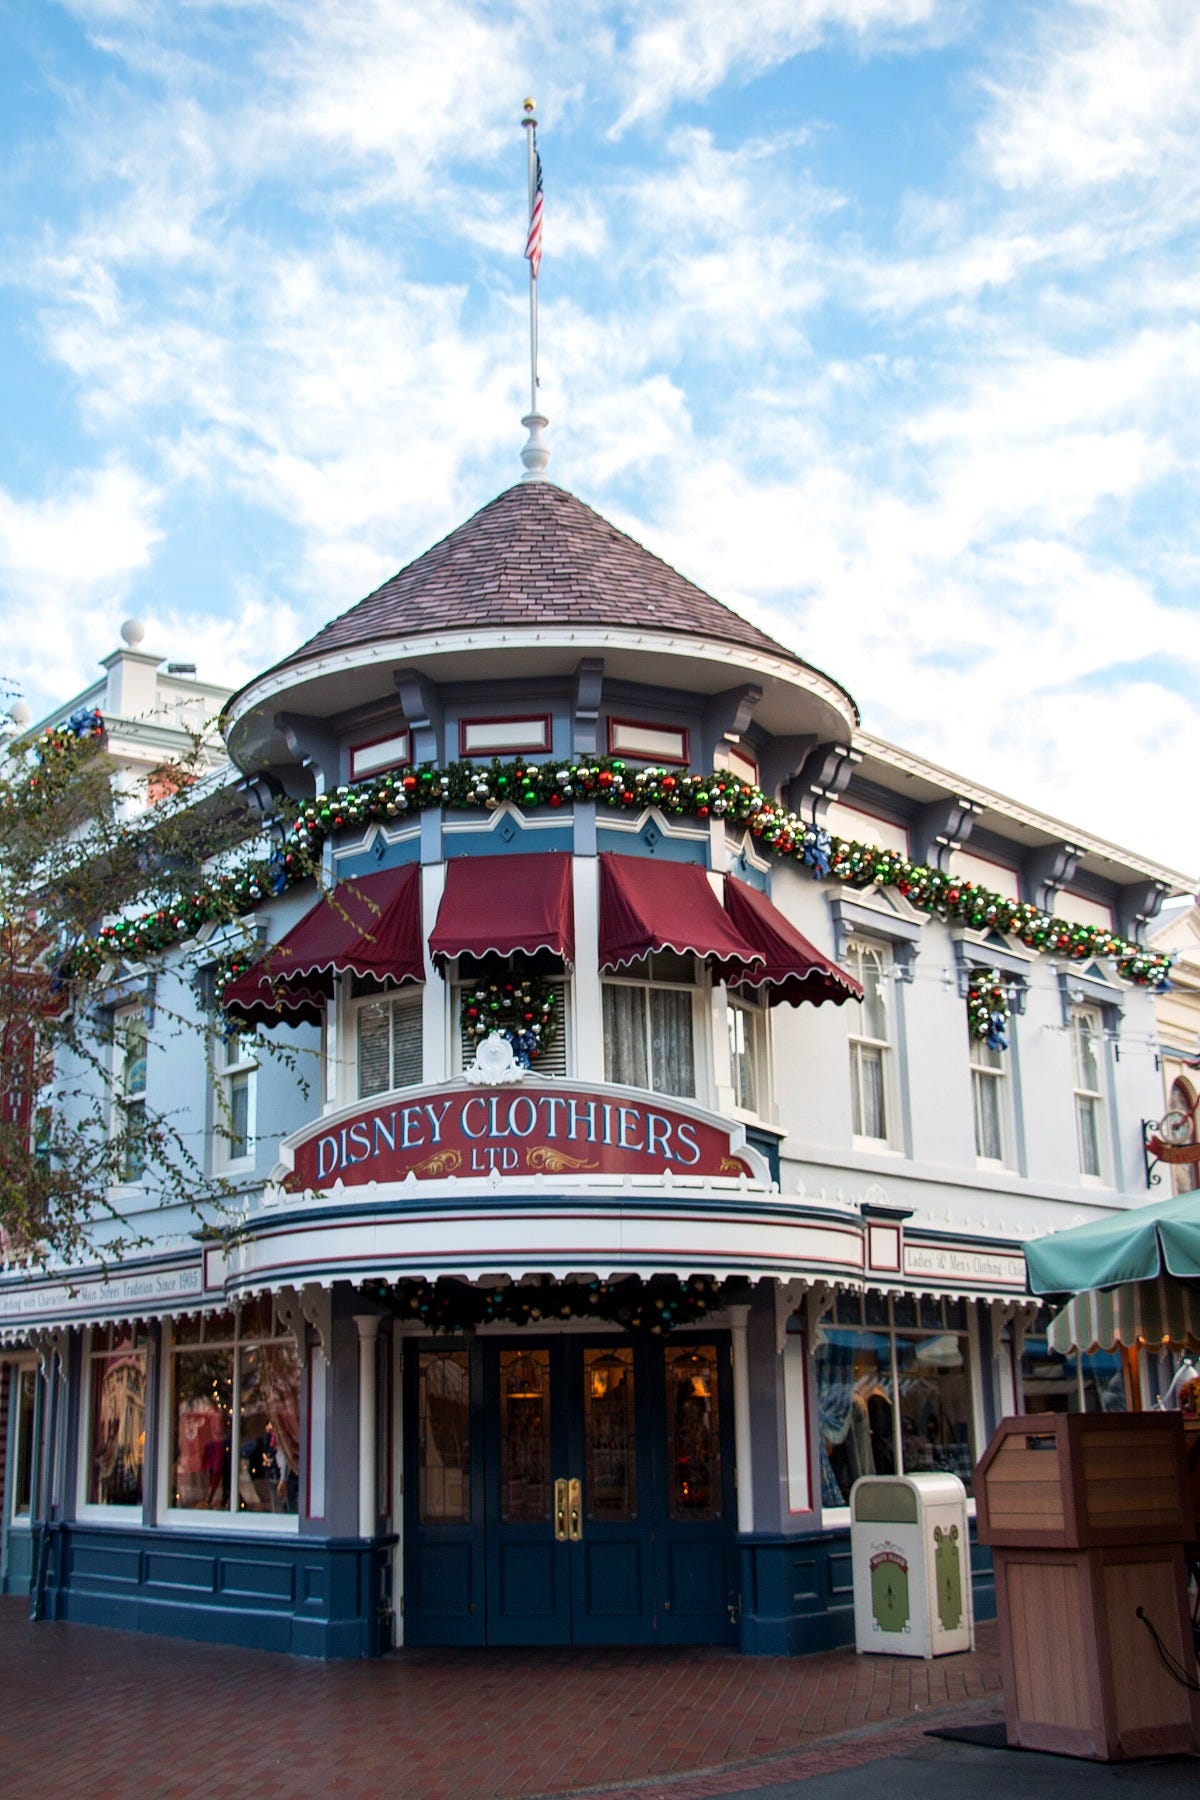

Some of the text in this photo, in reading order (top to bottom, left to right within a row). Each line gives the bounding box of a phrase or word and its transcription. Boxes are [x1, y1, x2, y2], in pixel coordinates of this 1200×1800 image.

[317, 1096, 701, 1180] DISNEY CLOTHIERS
[471, 1147, 519, 1170] LTD.
[936, 1253, 946, 1270] &
[156, 1275, 176, 1293] Since
